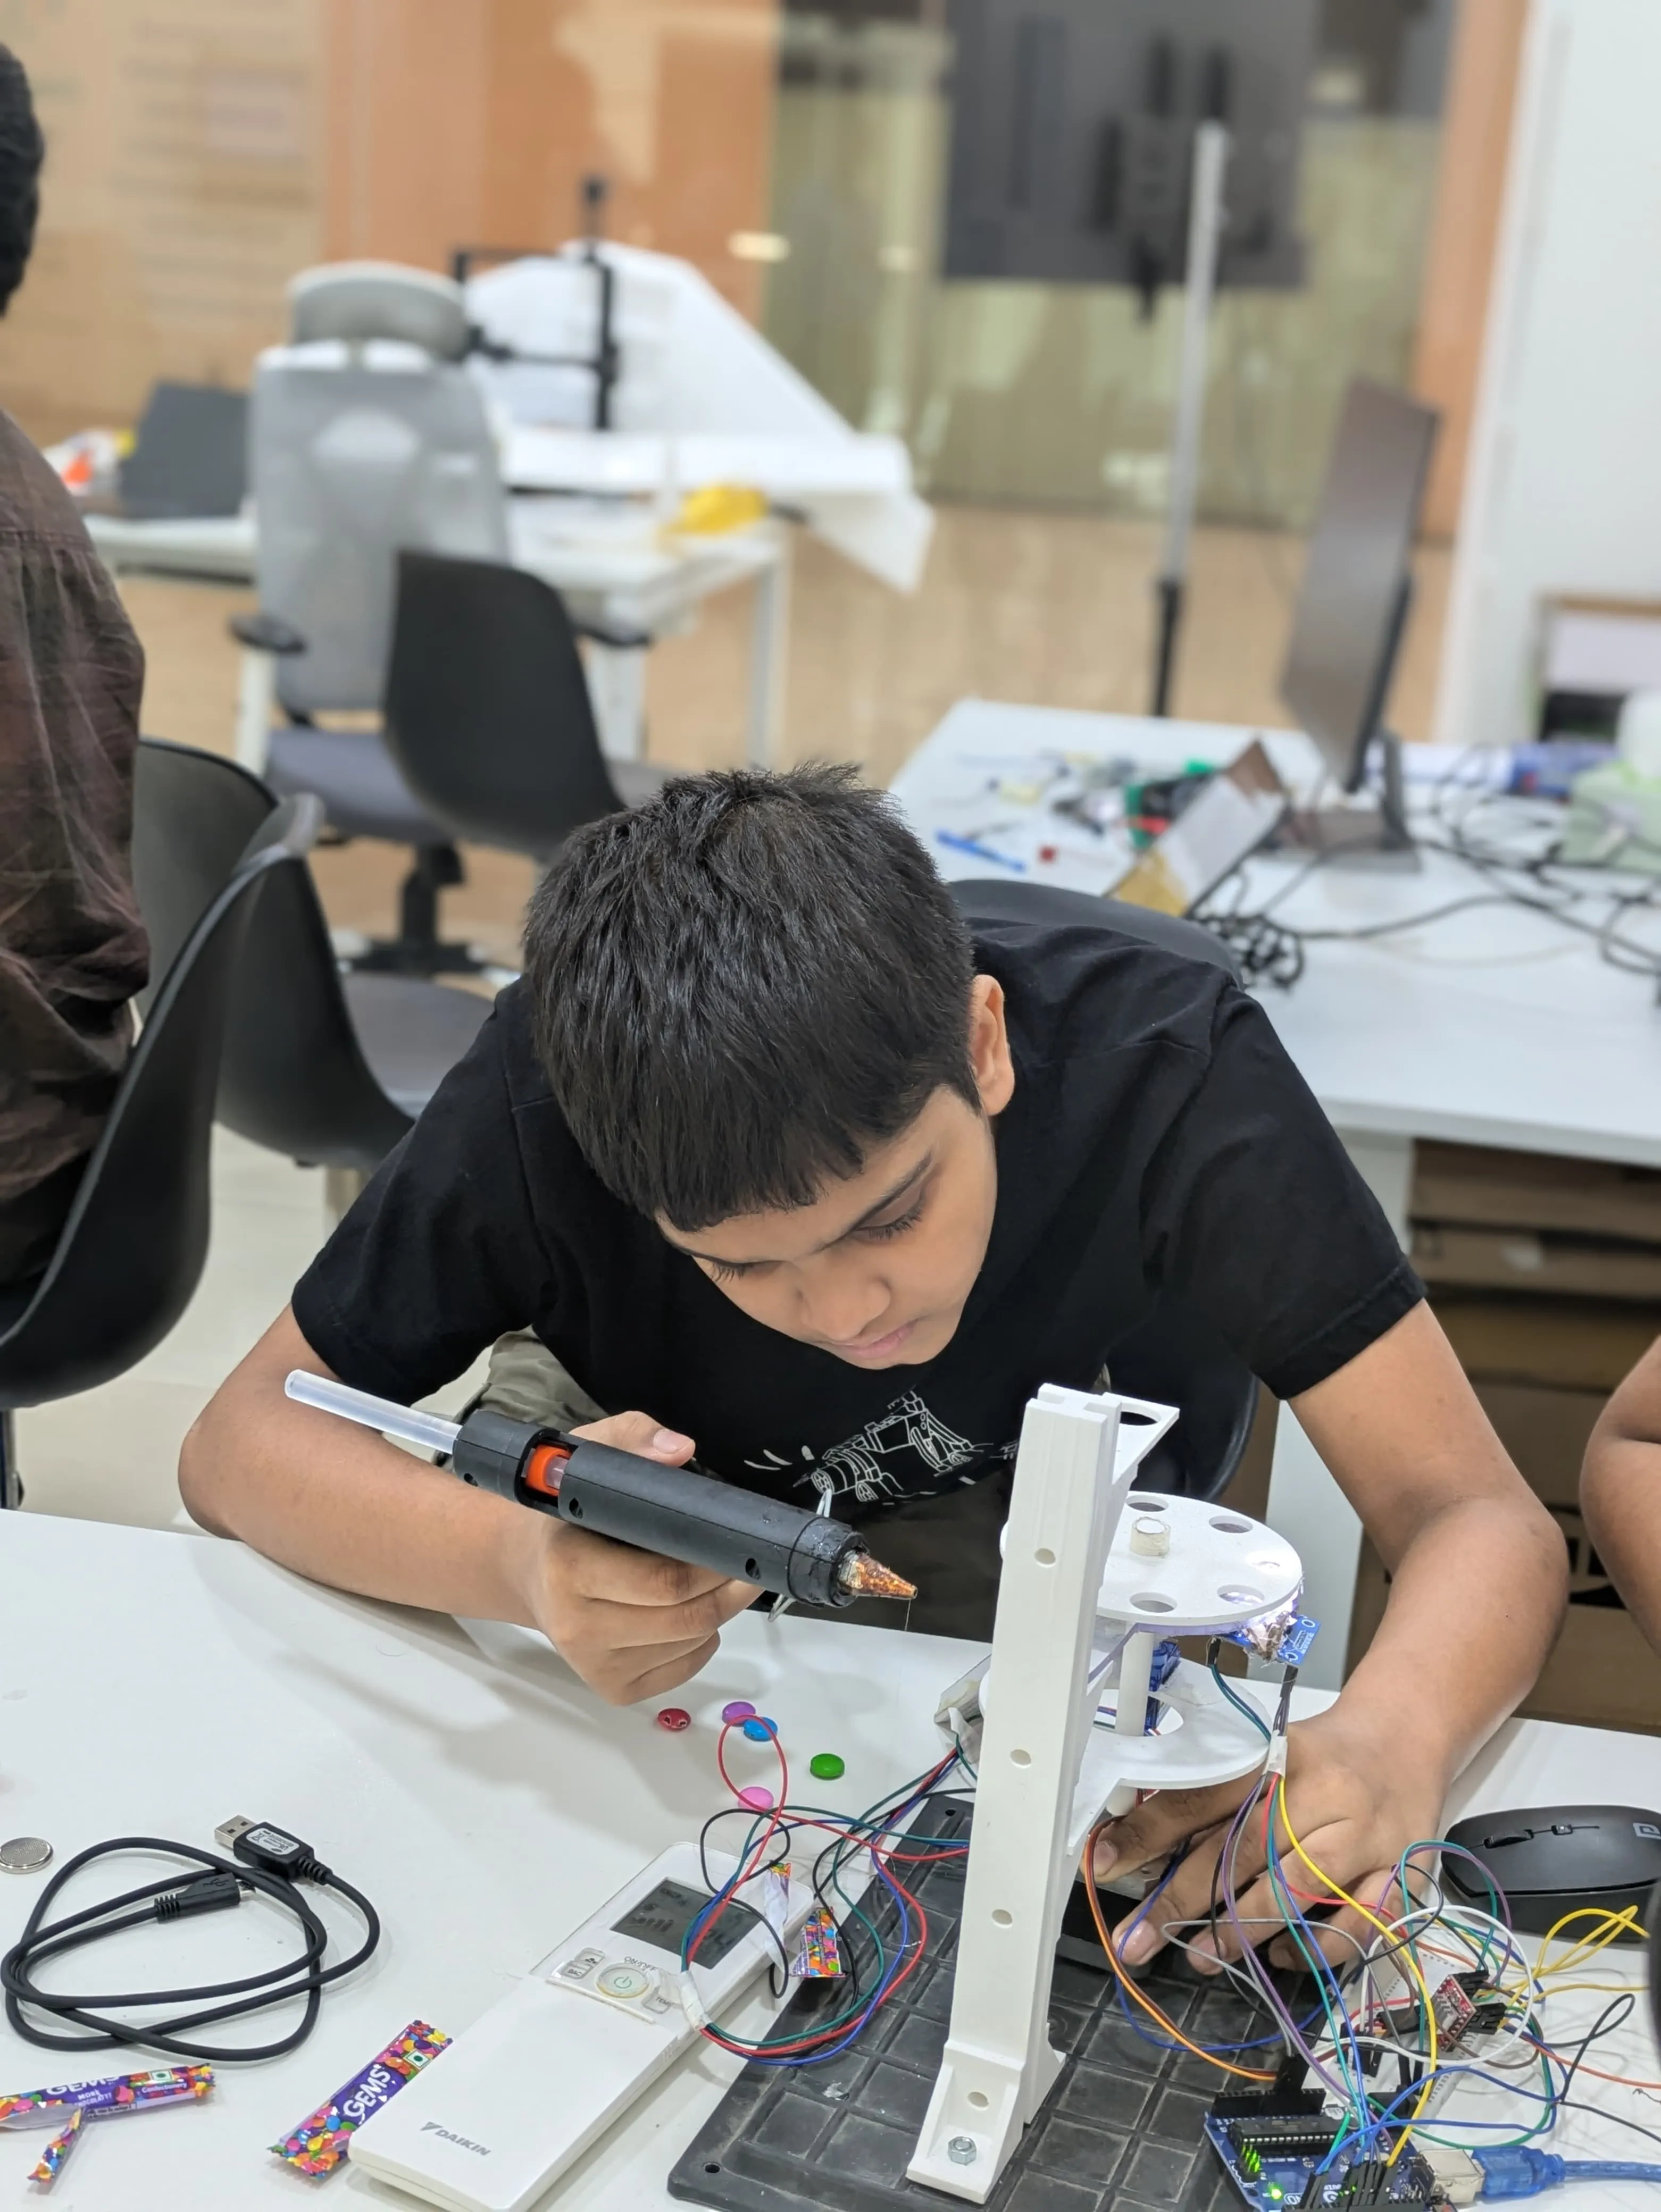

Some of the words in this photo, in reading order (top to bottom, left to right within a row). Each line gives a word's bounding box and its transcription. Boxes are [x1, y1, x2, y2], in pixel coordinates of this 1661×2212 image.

[77, 2089, 101, 2100] MORE
[141, 2082, 187, 2093] Confectionery
[343, 2067, 391, 2117] GEMS
[434, 2129, 491, 2156] DAIKIN
